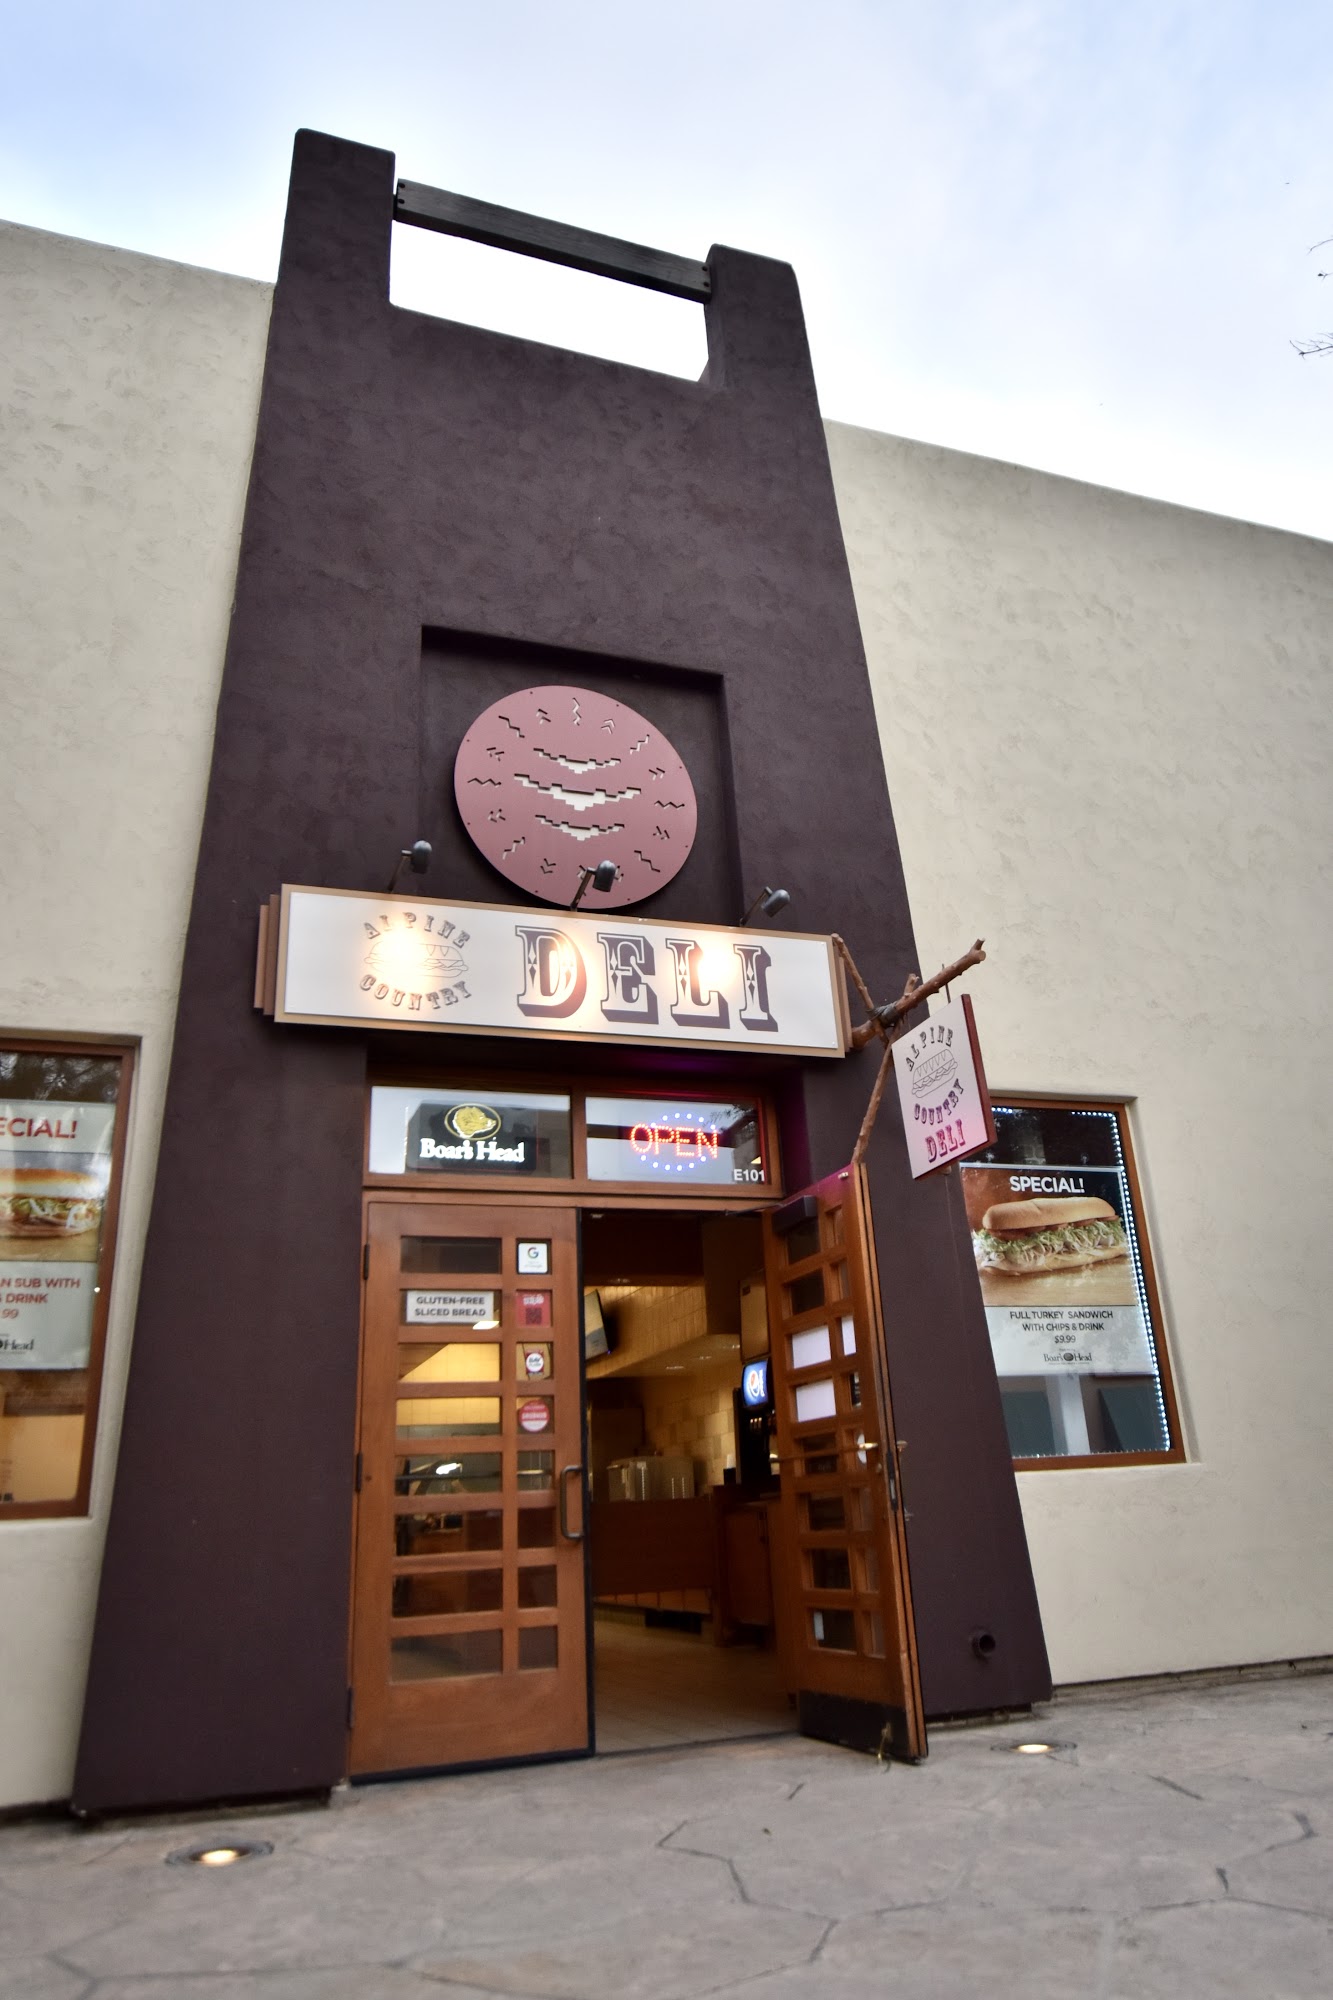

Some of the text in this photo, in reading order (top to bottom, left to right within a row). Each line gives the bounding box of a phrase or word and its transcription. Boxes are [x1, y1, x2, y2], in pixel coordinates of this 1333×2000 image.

[363, 912, 470, 948] ALPINE
[515, 925, 779, 1033] DELI
[360, 974, 472, 1010] COUNTRY
[905, 1025, 954, 1071] ALPINE
[914, 1078, 964, 1125] COUNTRY
[630, 1123, 718, 1159] OPEN
[925, 1118, 966, 1163] DELI
[475, 1137, 525, 1162] Head
[733, 1168, 765, 1182] E101
[1009, 1175, 1085, 1194] SPECIAL!
[14, 1277, 41, 1288] SUB
[45, 1278, 81, 1289] WITH
[5, 1293, 48, 1304] DRINK
[416, 1296, 485, 1305] GLUTEN-FREE
[414, 1308, 486, 1317] SLICED BREAD
[1010, 1310, 1114, 1320] FULL TURKEY SANDWICH
[1022, 1322, 1105, 1332] WITH CHIPS & DRINK
[4, 1339, 35, 1351] Head
[1054, 1334, 1076, 1344] $9.99
[1073, 1352, 1093, 1362] Head
